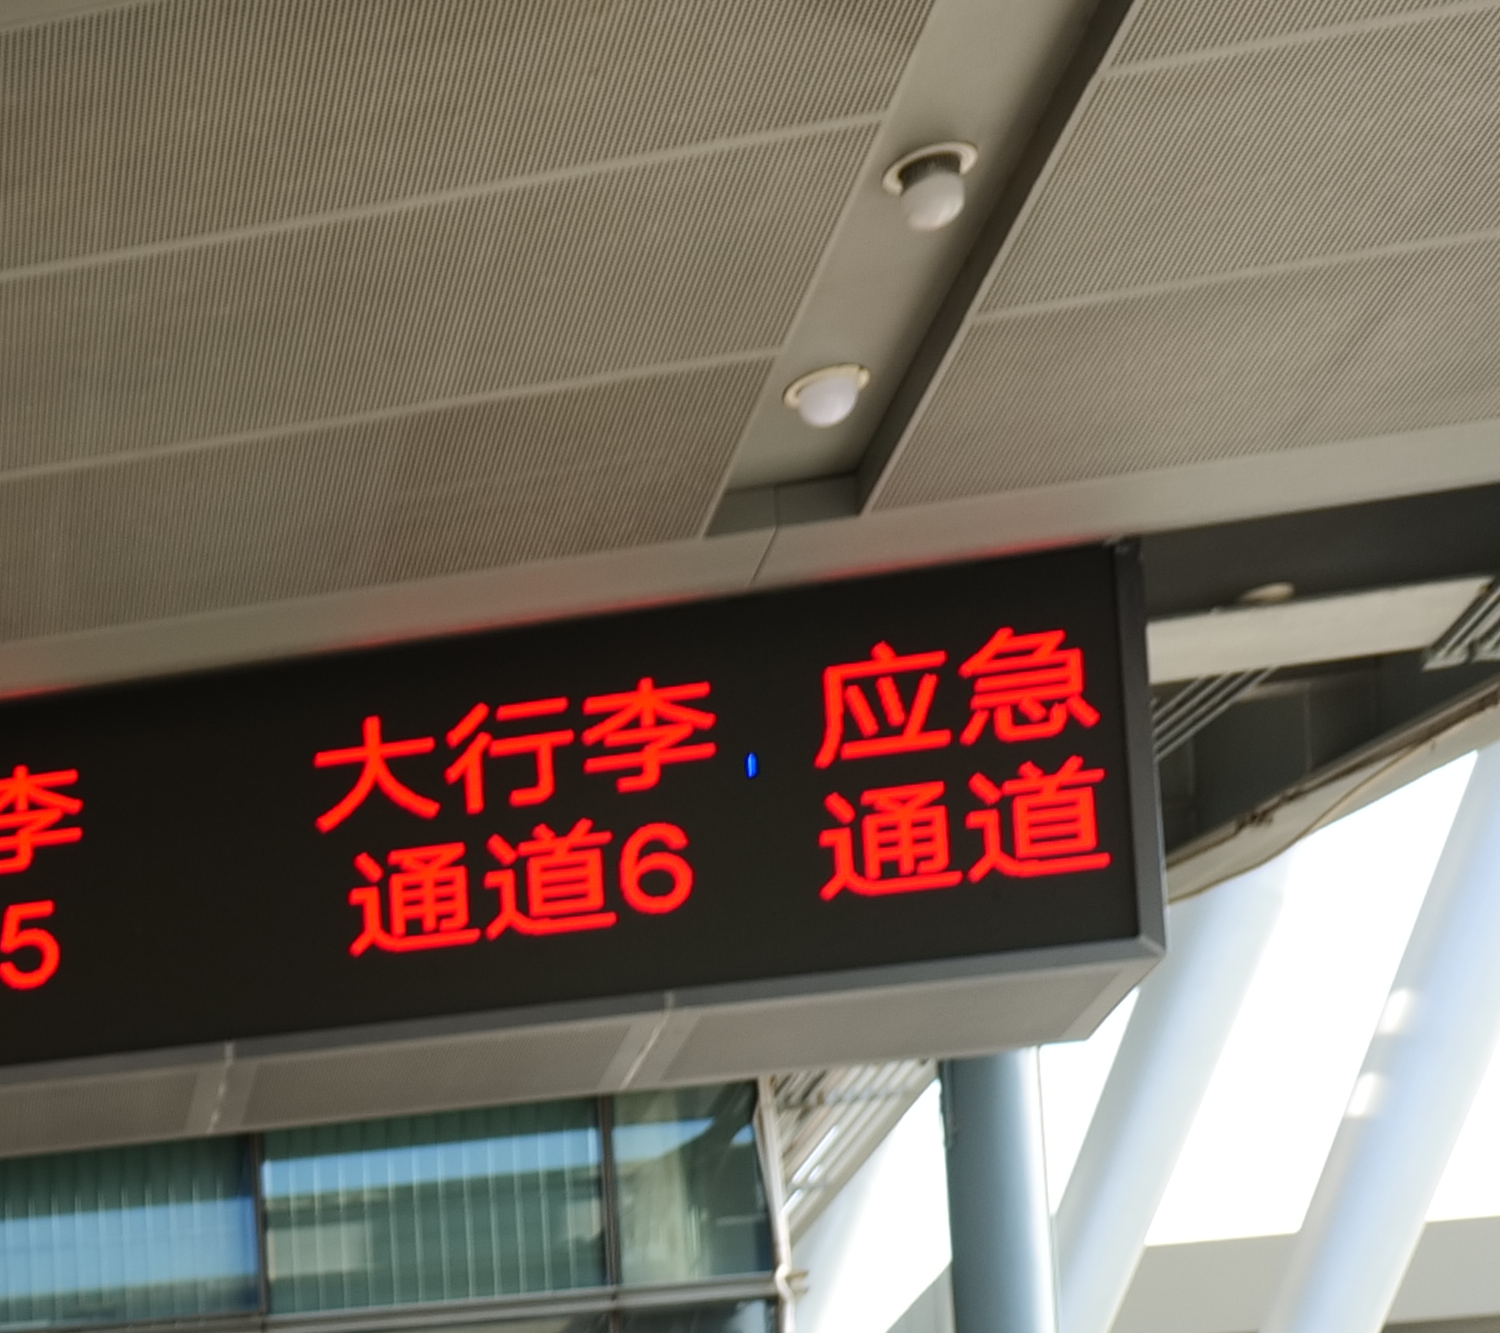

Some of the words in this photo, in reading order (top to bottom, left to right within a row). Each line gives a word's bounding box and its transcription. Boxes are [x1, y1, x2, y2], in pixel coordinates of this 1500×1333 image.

[313, 676, 719, 833] 大行李
[813, 626, 1101, 769] 应急
[347, 816, 694, 957] 通道6
[817, 754, 1112, 901] 通道
